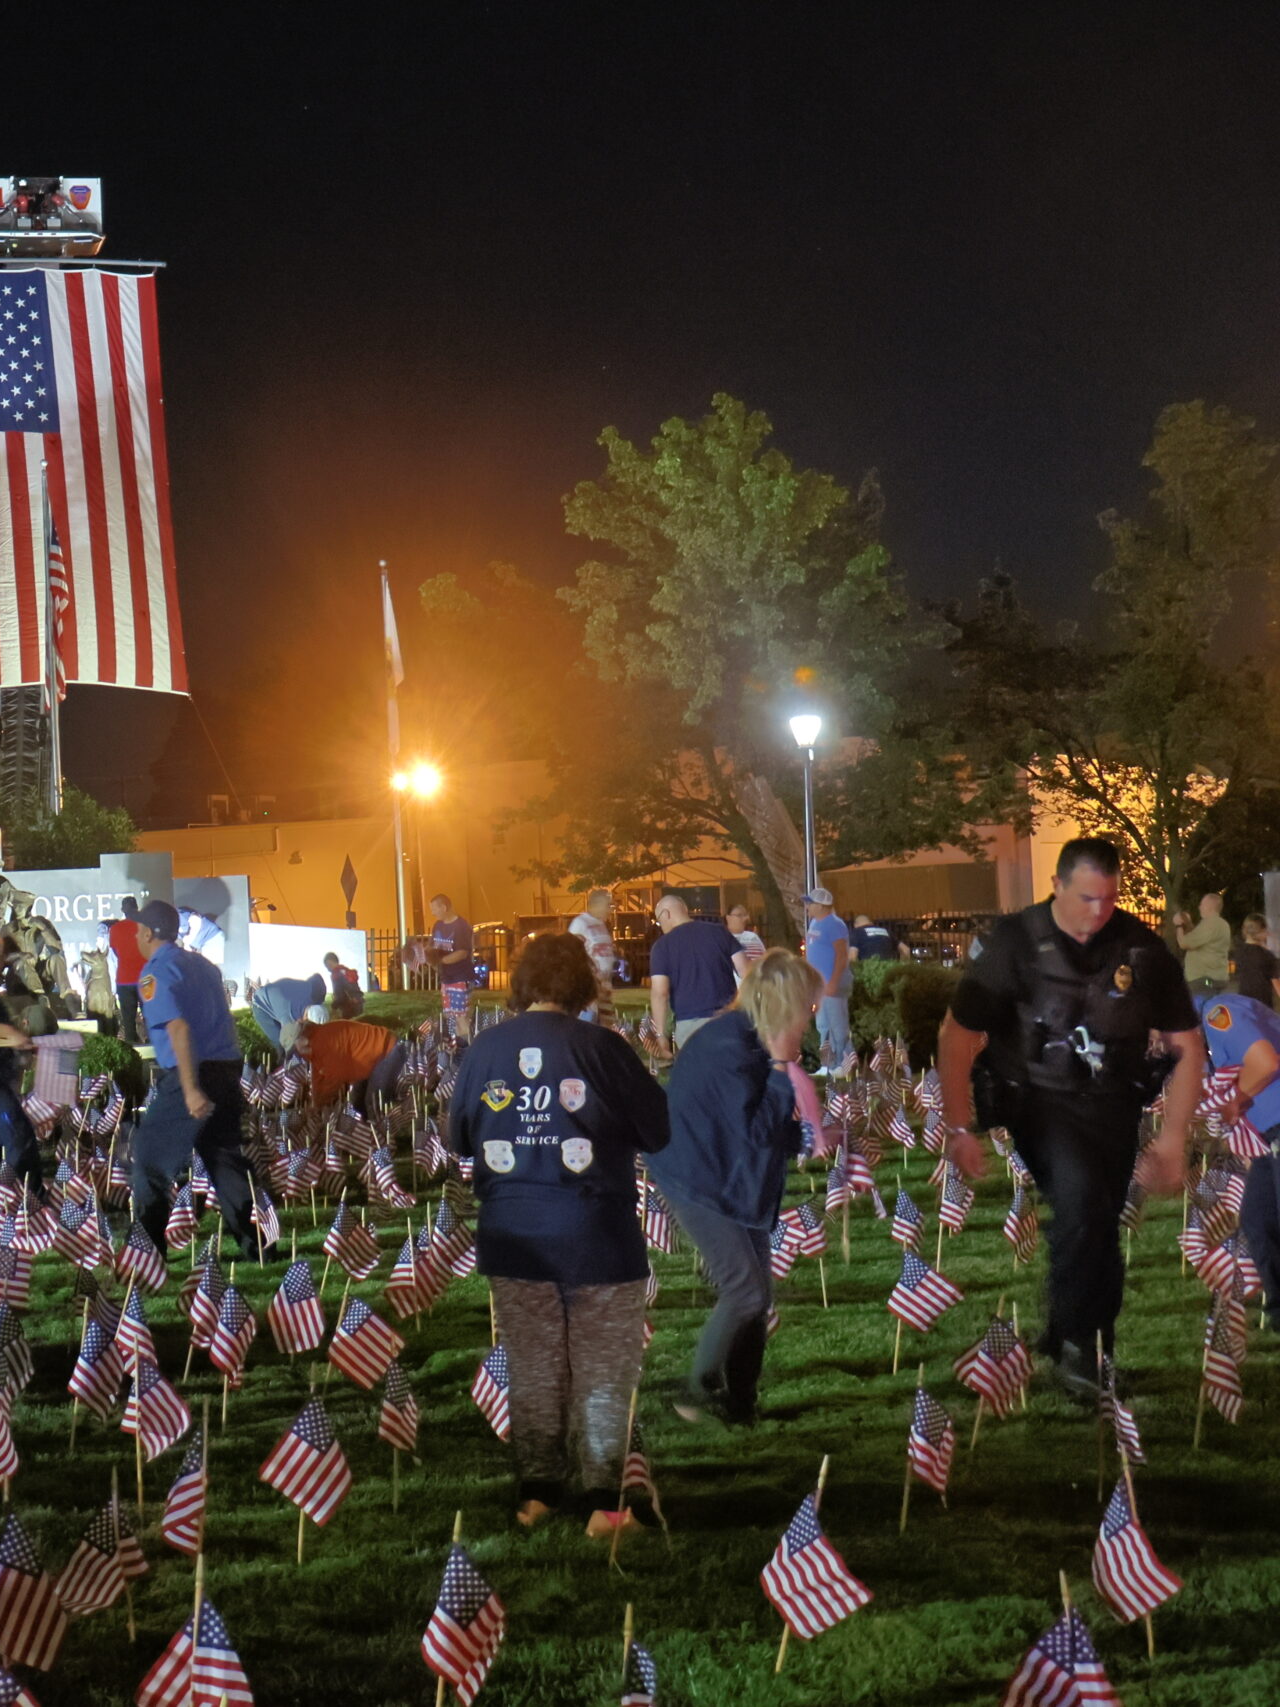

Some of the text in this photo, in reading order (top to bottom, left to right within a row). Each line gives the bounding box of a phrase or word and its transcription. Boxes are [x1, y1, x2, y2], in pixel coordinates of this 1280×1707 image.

[516, 1086, 552, 1111] 30
[520, 1113, 551, 1122] YEARS
[527, 1125, 542, 1134] OF
[515, 1135, 559, 1145] SERVICE
